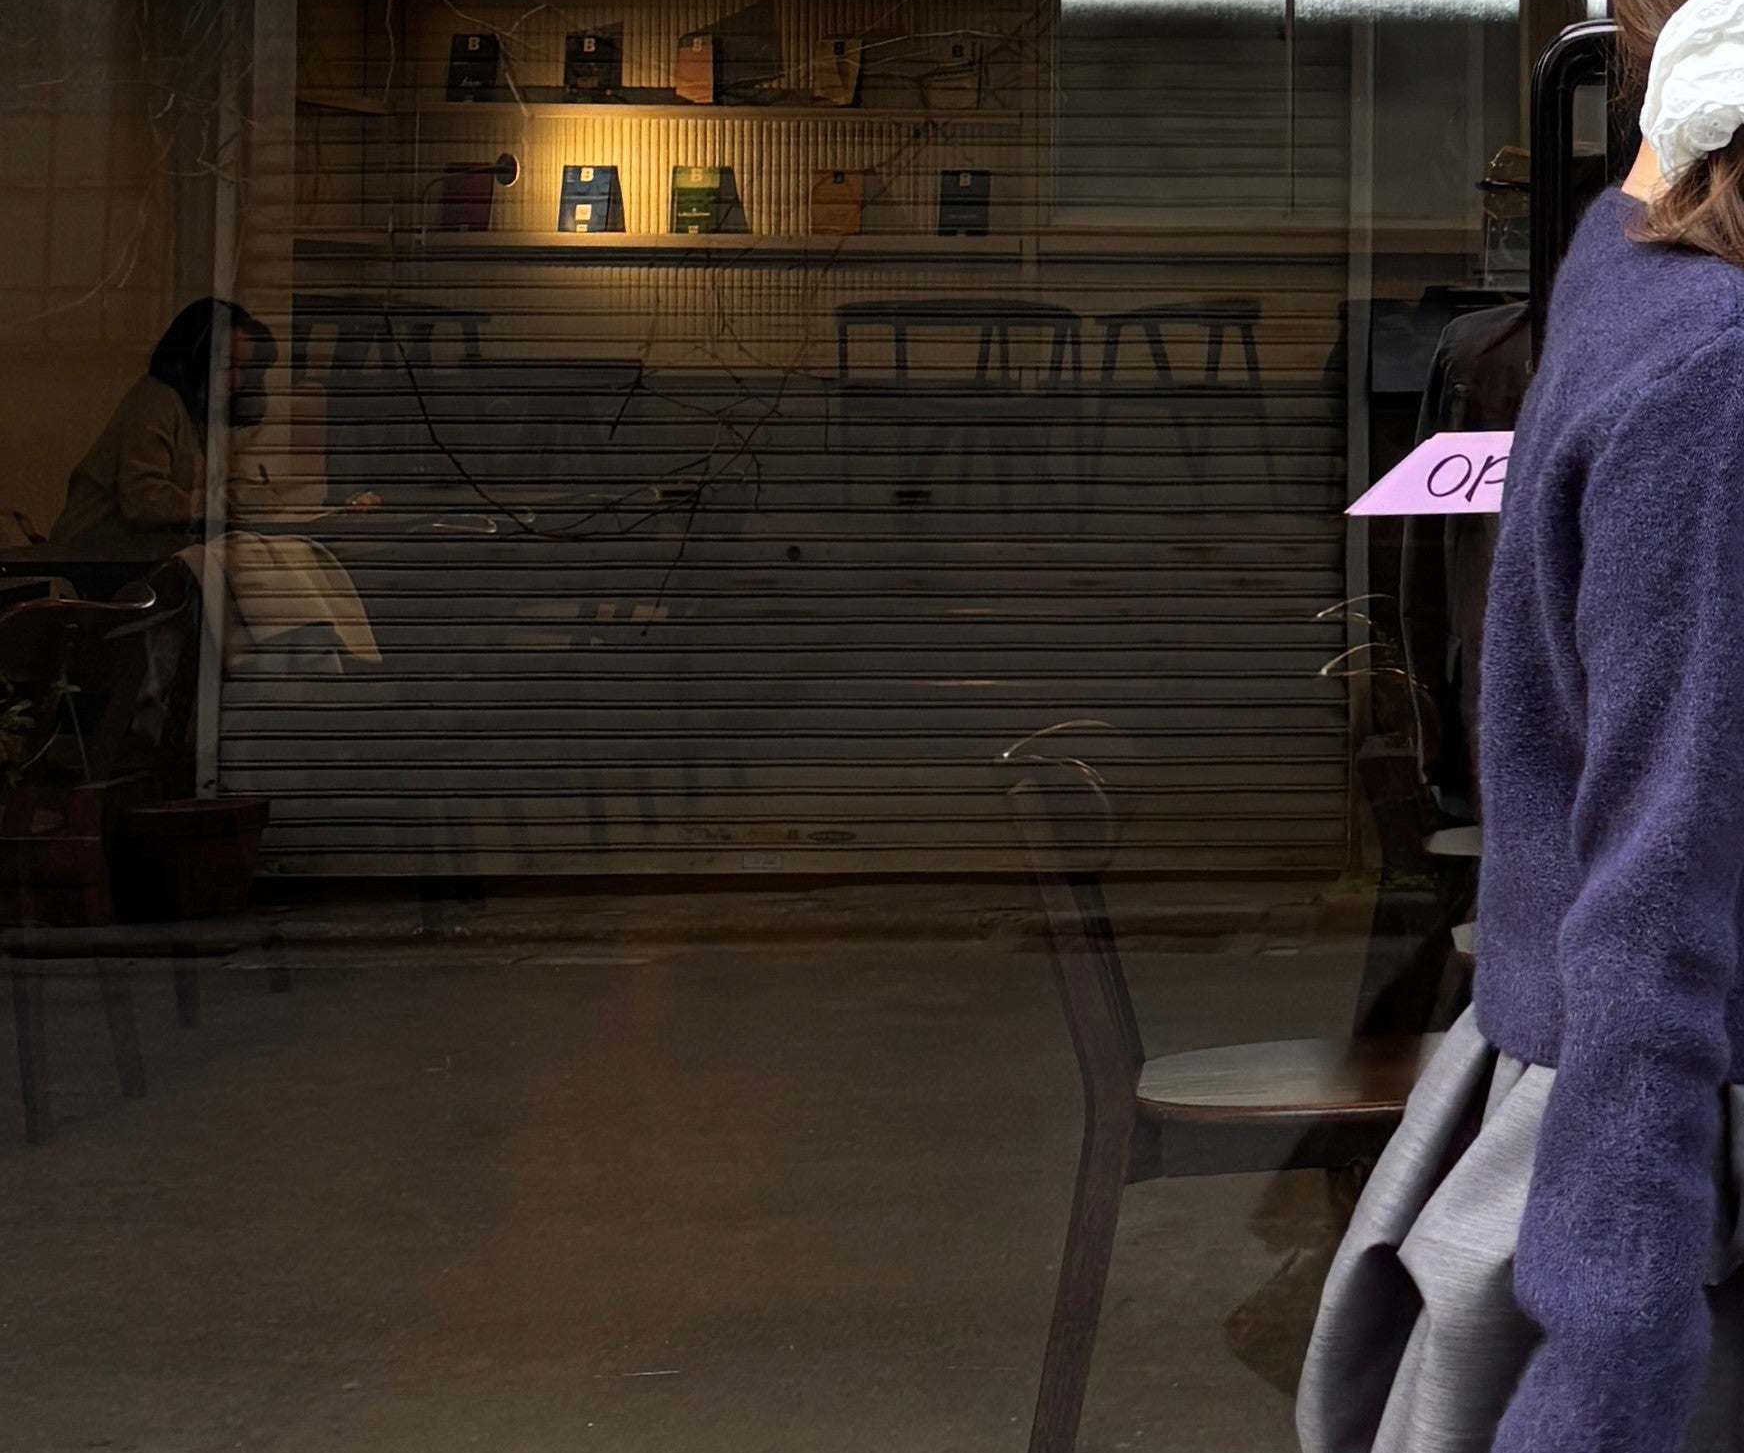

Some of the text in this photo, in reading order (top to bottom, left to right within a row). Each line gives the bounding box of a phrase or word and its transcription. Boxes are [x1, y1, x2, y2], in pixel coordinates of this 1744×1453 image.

[467, 36, 481, 51] B
[583, 37, 596, 52] B
[580, 167, 594, 182] B
